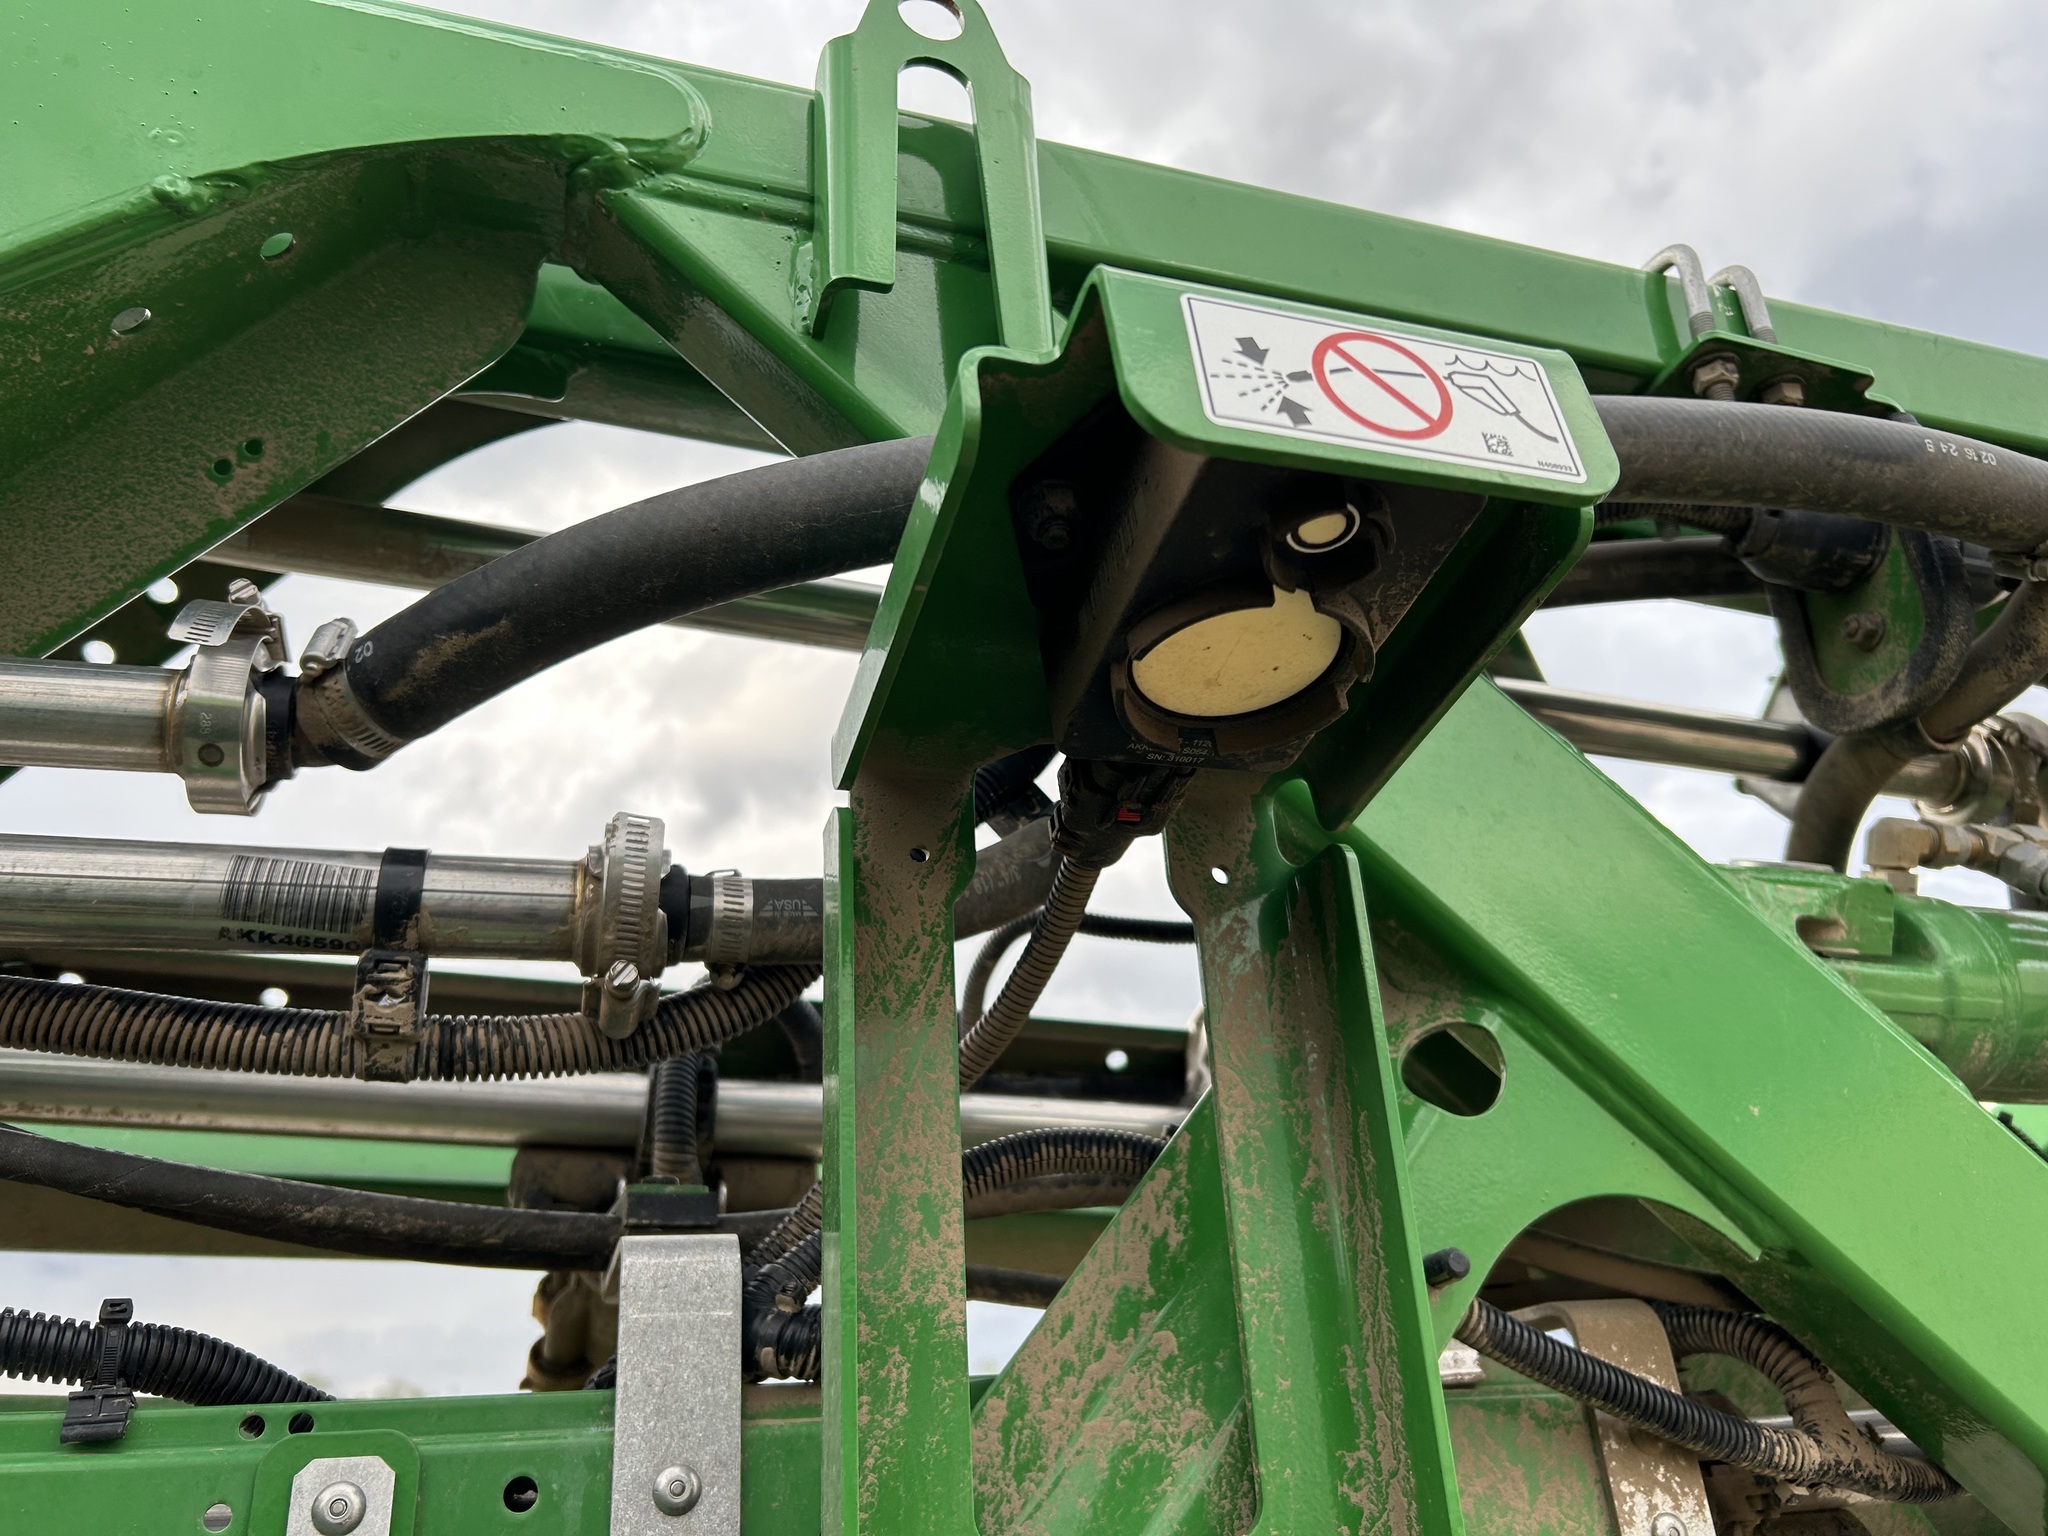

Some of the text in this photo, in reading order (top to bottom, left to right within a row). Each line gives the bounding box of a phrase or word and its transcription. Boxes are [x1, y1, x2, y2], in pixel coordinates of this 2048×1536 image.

[1146, 753, 1205, 765] SN: 310017
[774, 899, 802, 911] USA
